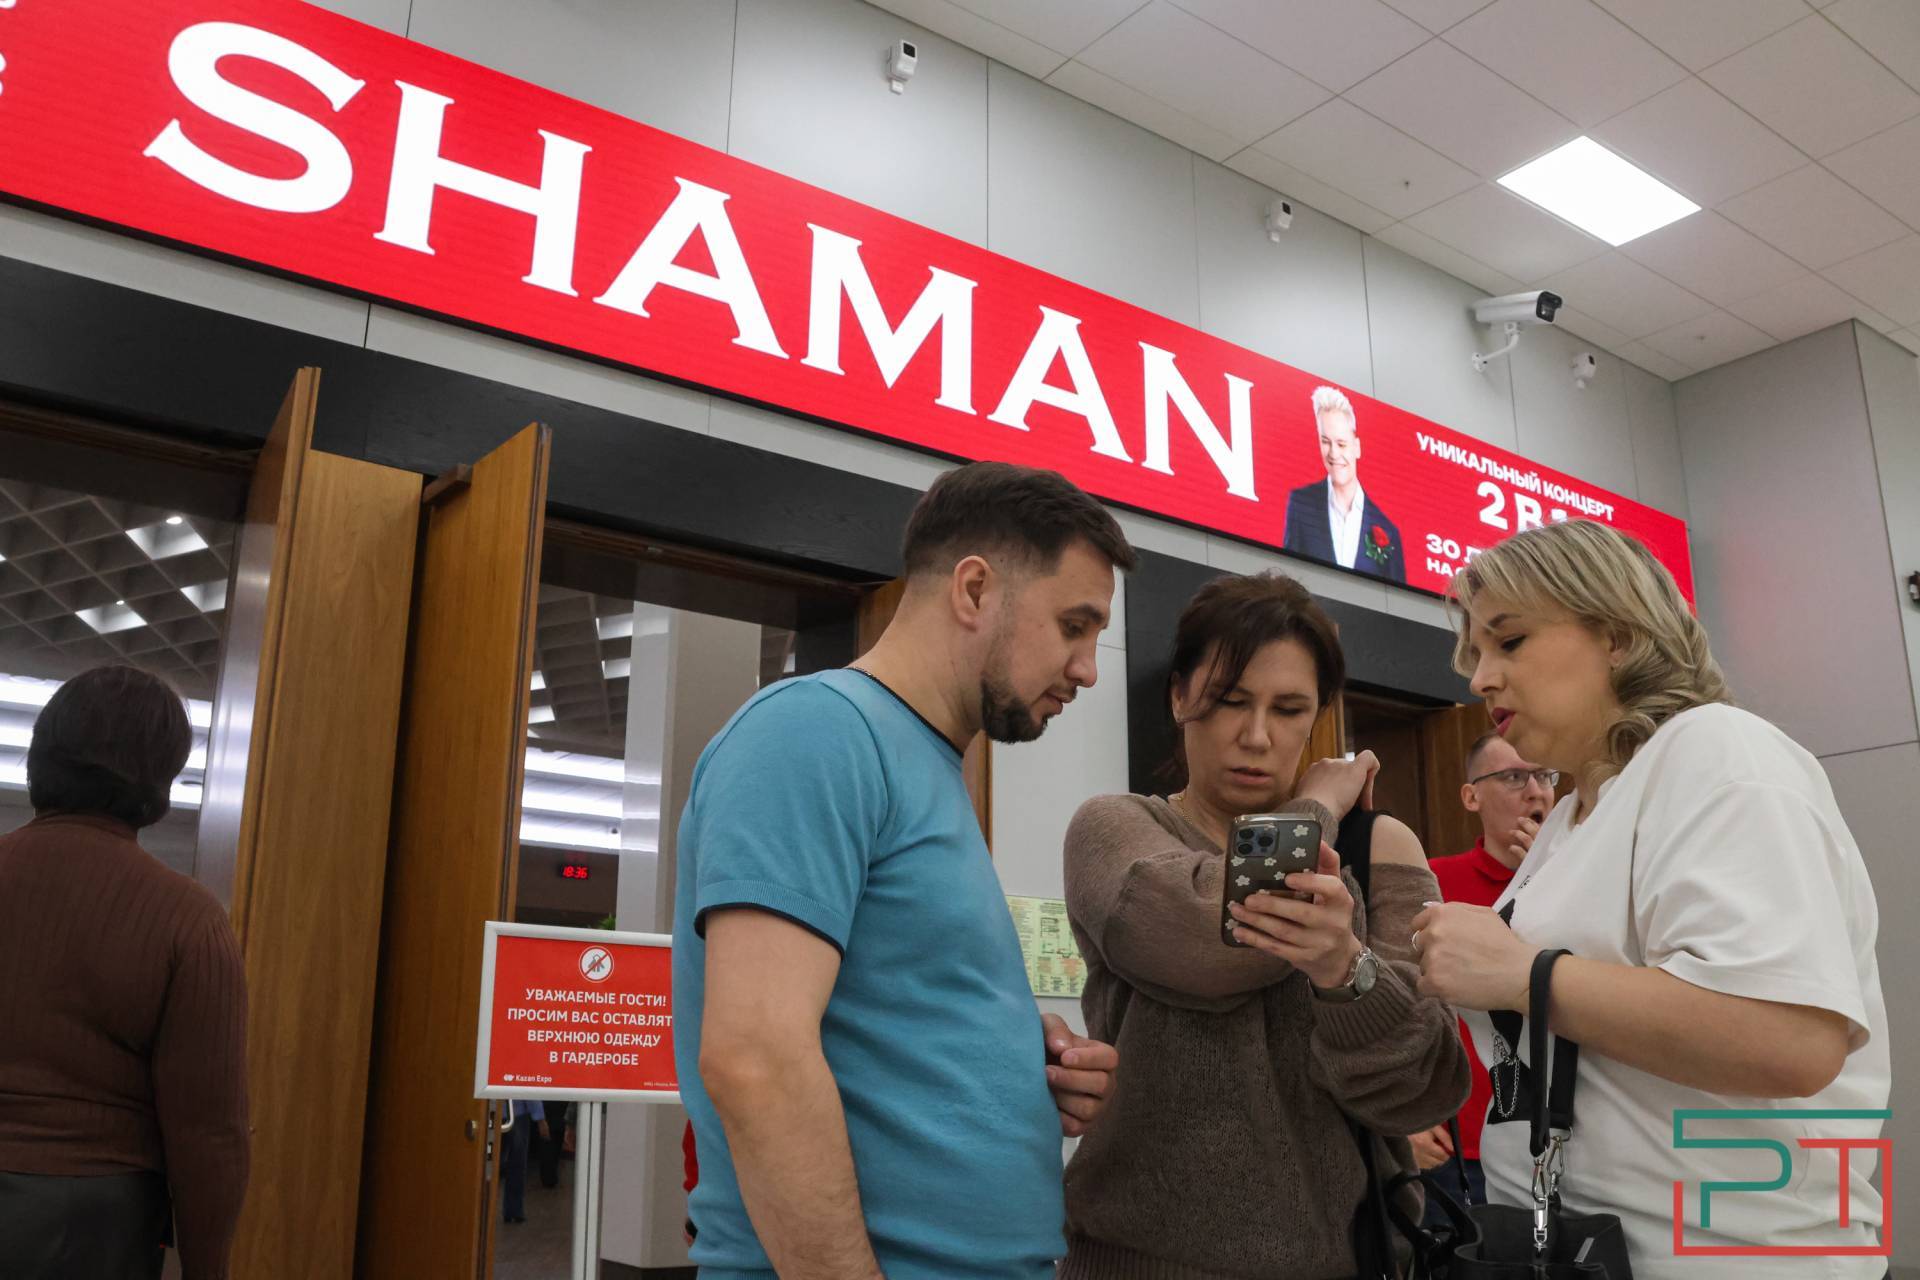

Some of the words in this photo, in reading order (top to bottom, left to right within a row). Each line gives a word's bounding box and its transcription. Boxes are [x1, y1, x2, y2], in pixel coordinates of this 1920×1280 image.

[144, 21, 1260, 502] SHAMAN
[1416, 431, 1542, 495] УНИКАЛЬНЫЙ
[1543, 481, 1615, 521] КОНЦЕРТ
[1477, 481, 1509, 531] 2
[1425, 533, 1461, 560] 30
[1426, 557, 1454, 577] НА
[525, 988, 616, 1005] УВАЖАЕМЫЕ
[619, 993, 667, 1007] ГОСТИ!
[507, 1007, 568, 1022] ПРОСИМ
[571, 1010, 600, 1024] ВАС
[602, 1012, 673, 1027] ОСТАВЛЯТ
[527, 1029, 600, 1044] ВЕРХНЮЮ
[603, 1032, 661, 1048] ОДЕЖДУ
[549, 1050, 559, 1064] В
[561, 1052, 640, 1066] ГАРДЕРОБЕ
[515, 1073, 536, 1083] Kazan
[536, 1074, 553, 1085] Expo
